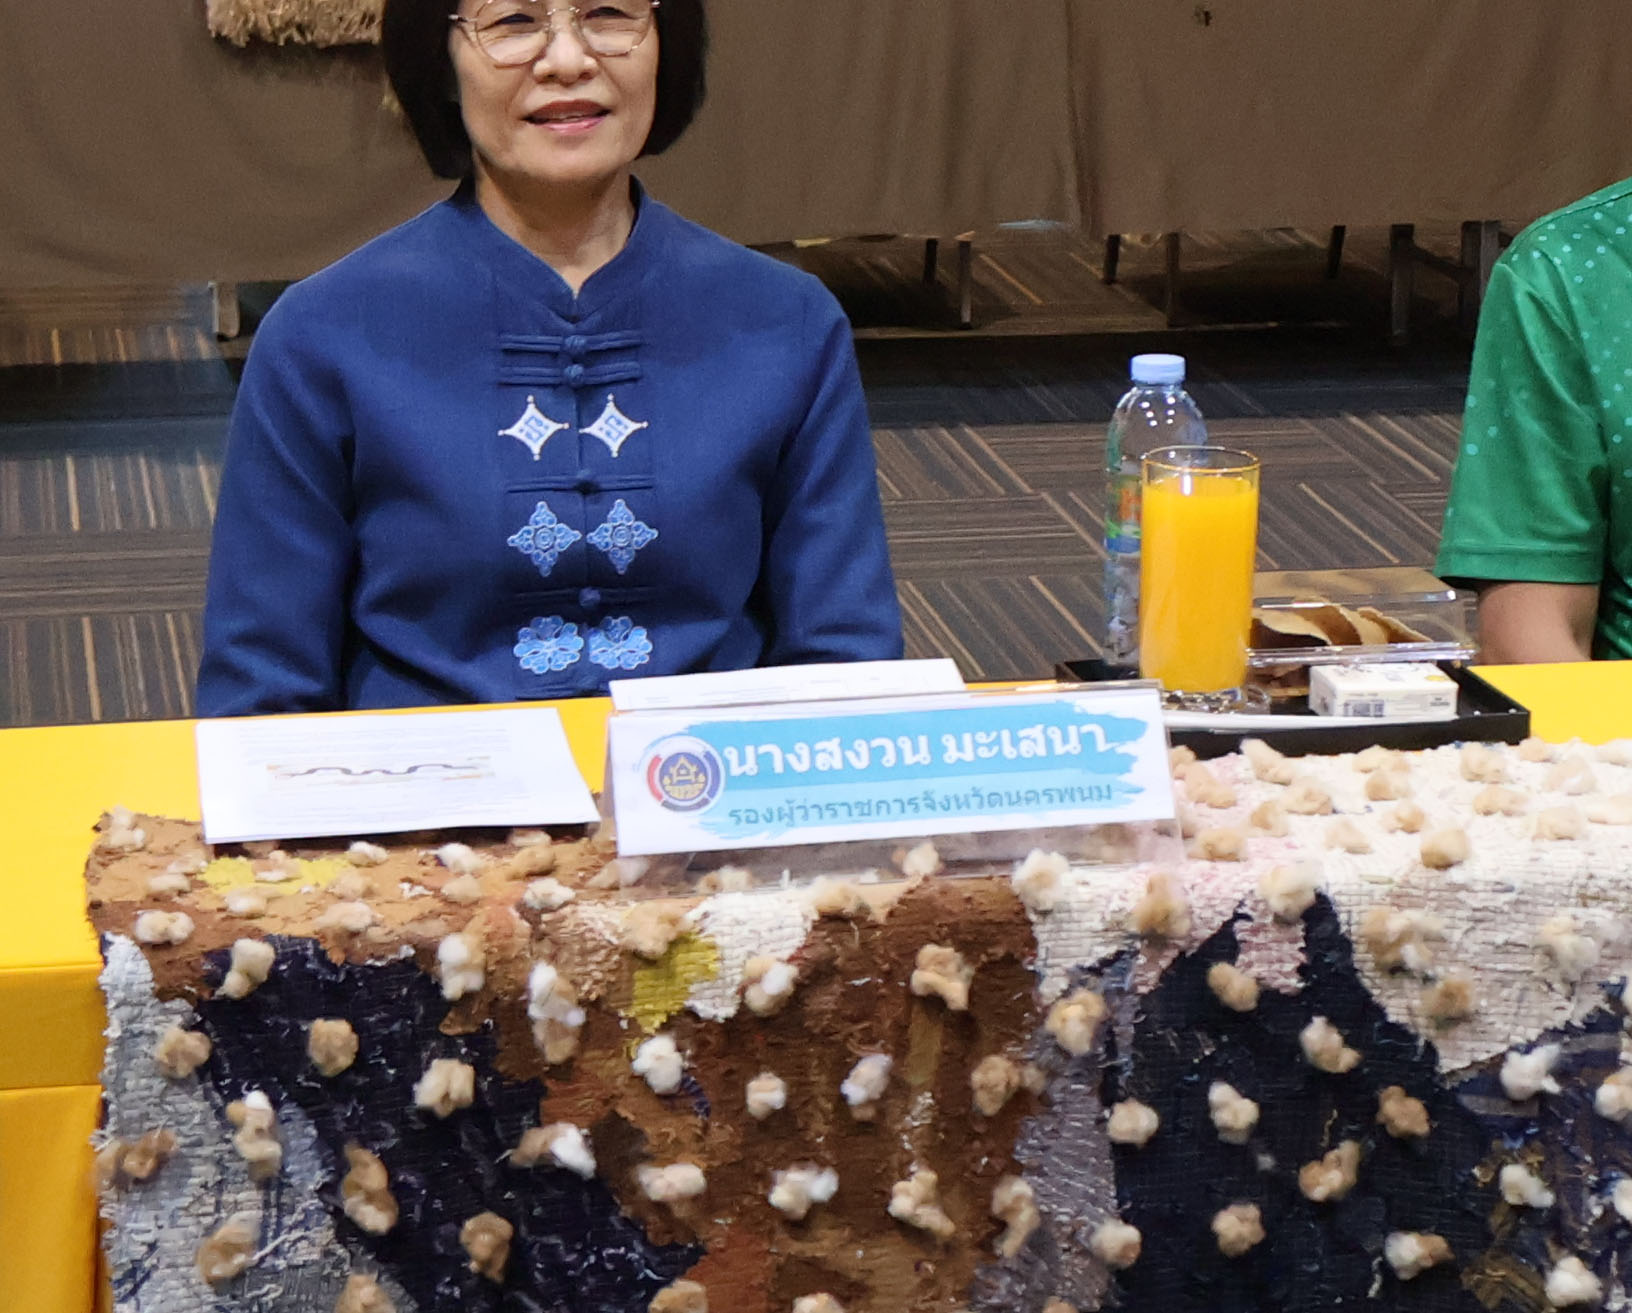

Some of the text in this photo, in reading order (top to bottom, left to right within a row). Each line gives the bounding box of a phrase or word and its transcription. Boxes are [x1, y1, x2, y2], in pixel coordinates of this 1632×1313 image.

[722, 722, 1113, 777] นางสงวน มะเสนา
[728, 783, 1113, 828] รองผู้ว่าราชการจังหวัดนครพนม
